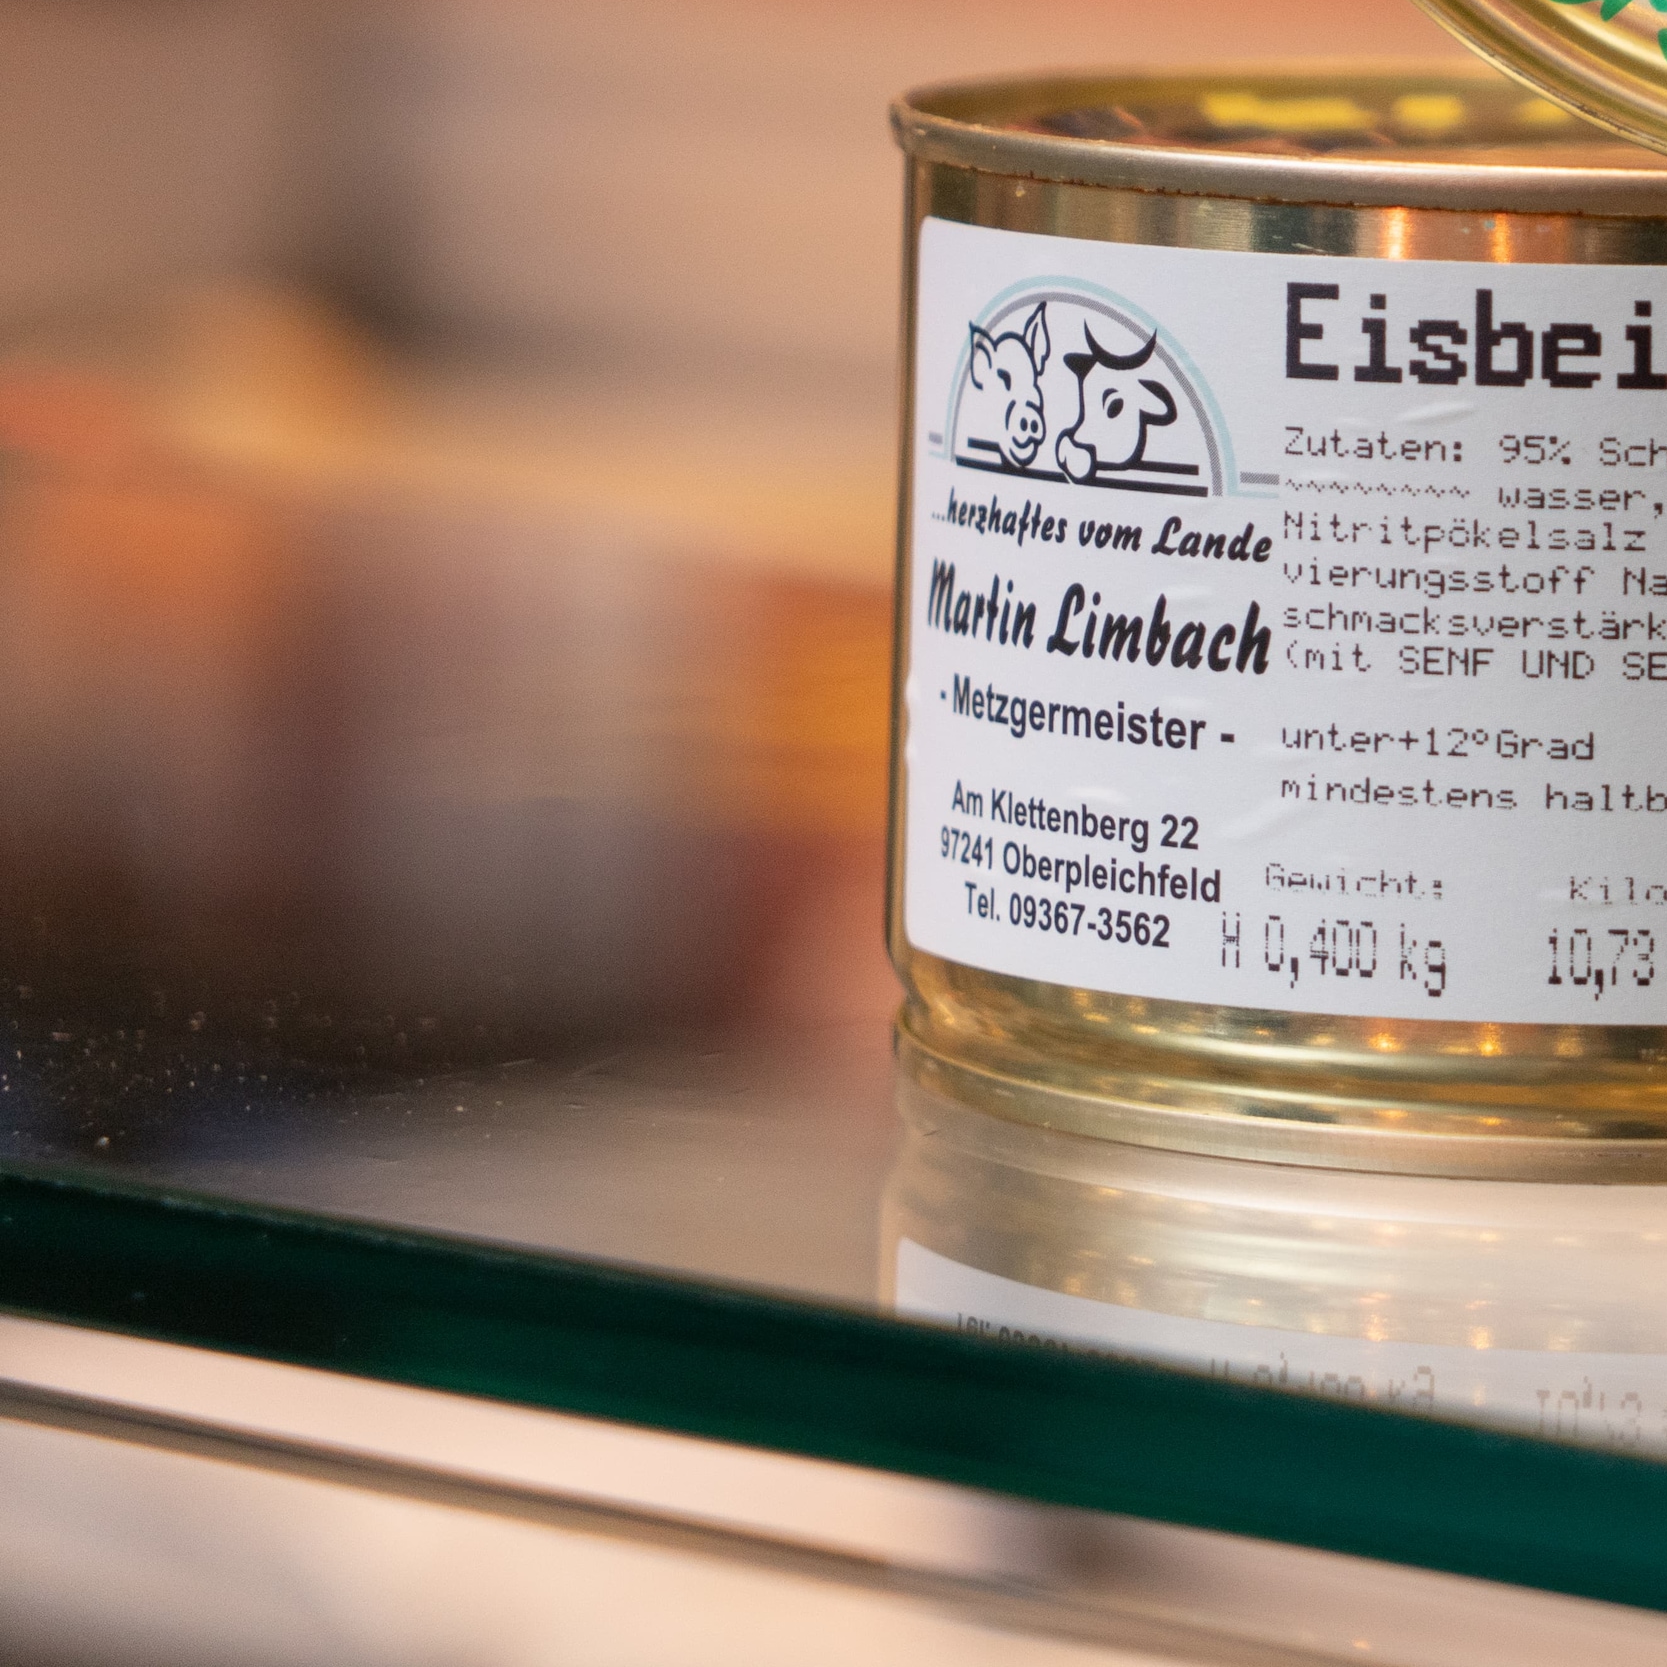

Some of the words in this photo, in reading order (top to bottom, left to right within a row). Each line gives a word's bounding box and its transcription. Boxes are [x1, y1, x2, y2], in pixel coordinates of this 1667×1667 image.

[1284, 426, 1463, 462] Zutaten:
[1499, 434, 1571, 465] 95%
[1499, 487, 1664, 518] wasser,
[1079, 518, 1141, 551] vom
[1152, 515, 1272, 563] Lande
[1284, 511, 1647, 553] Nitritpökelsalz
[1283, 558, 1595, 598] vierungsstoff
[928, 557, 1036, 649] Martin
[1047, 582, 1270, 675] Limbach
[1286, 641, 1371, 671] (mit
[1399, 645, 1495, 678] SENF
[1521, 649, 1595, 679] UND
[952, 673, 1206, 750] Metzgermeister
[1281, 774, 1517, 809] mindestens
[951, 780, 983, 818] Am
[991, 790, 1149, 853] Klettenberg
[1161, 814, 1199, 850] 22
[941, 826, 993, 871] 97241
[1003, 842, 1221, 903] Oberpleichfeld
[1265, 863, 1443, 900] Gewicht:
[964, 882, 1000, 922] Tel.
[1009, 893, 1170, 948] 09367-3562
[1265, 915, 1377, 989] 0,400
[1400, 923, 1446, 997] kg
[1548, 928, 1654, 1001] 10,73
